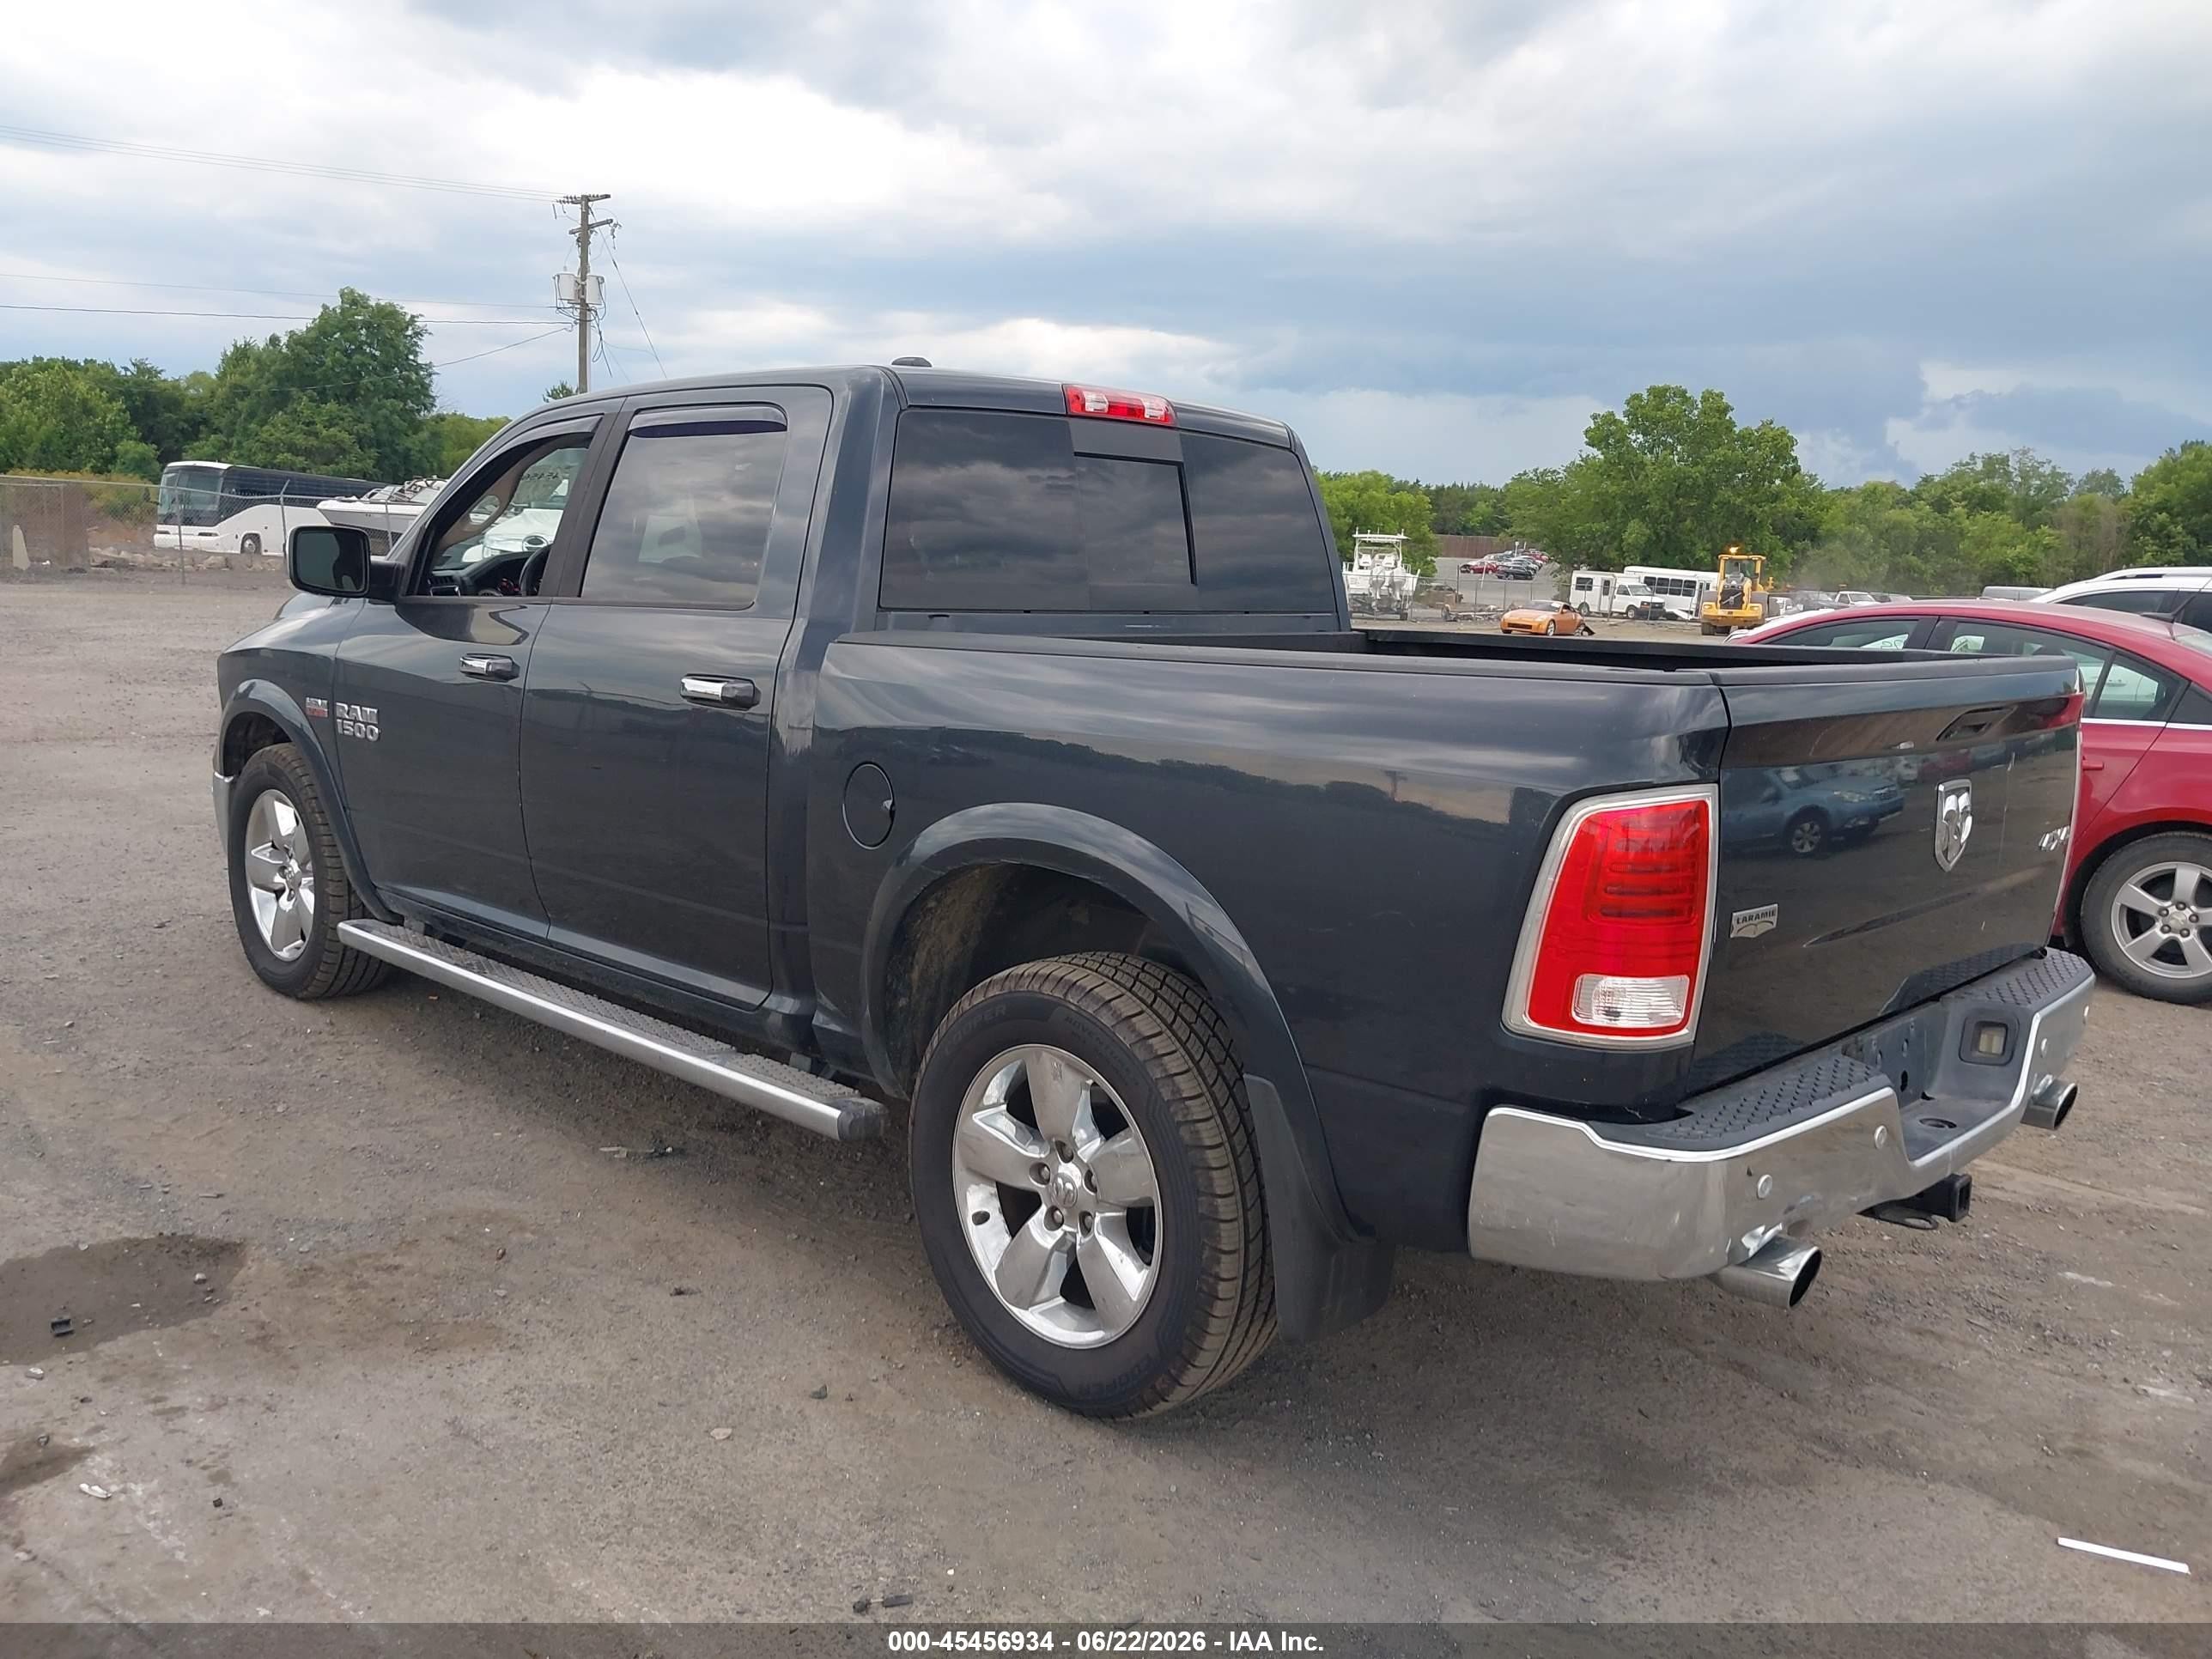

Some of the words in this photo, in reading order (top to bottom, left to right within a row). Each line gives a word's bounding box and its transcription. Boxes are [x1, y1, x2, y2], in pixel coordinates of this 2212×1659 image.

[336, 702, 379, 725] RAM
[336, 719, 380, 742] 1500
[1736, 909, 1776, 925] LARAMIE
